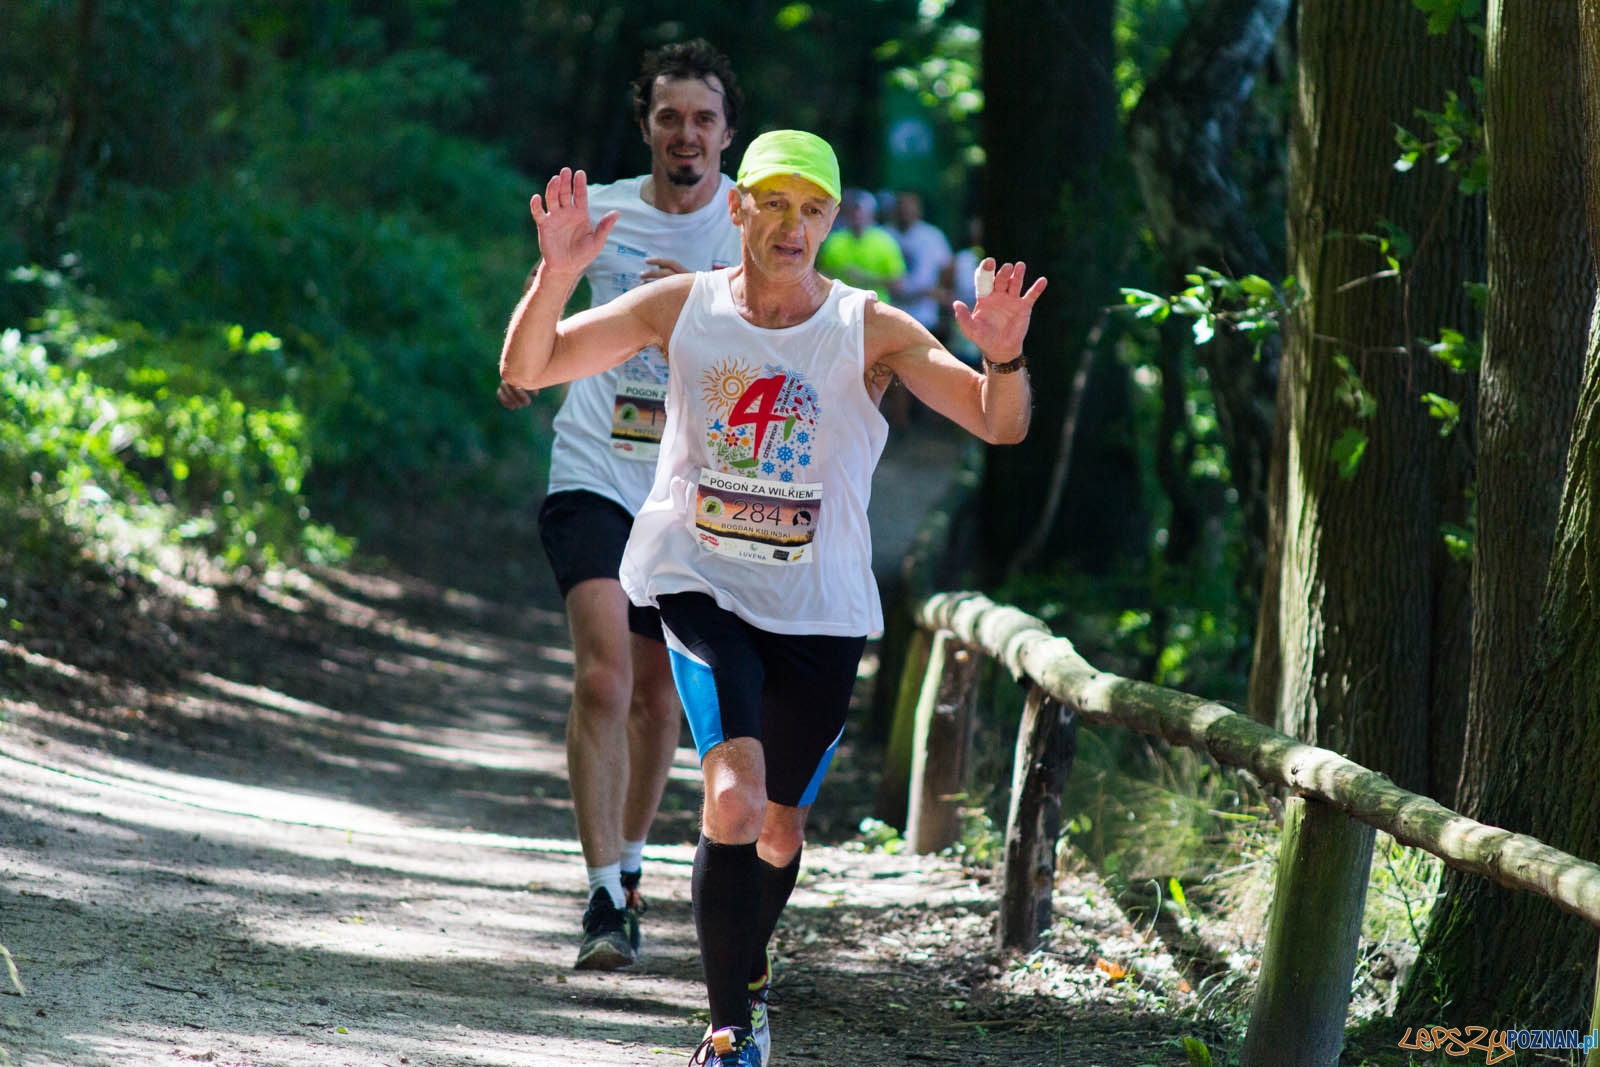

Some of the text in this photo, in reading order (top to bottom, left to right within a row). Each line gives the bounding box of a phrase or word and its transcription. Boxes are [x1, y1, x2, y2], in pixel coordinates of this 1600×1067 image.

[728, 374, 790, 462] 4
[751, 484, 766, 494] ZA
[768, 486, 814, 499] WILKIEM
[732, 500, 782, 526] 284
[721, 522, 754, 533] BOGDAN
[739, 550, 767, 561] LUVENA
